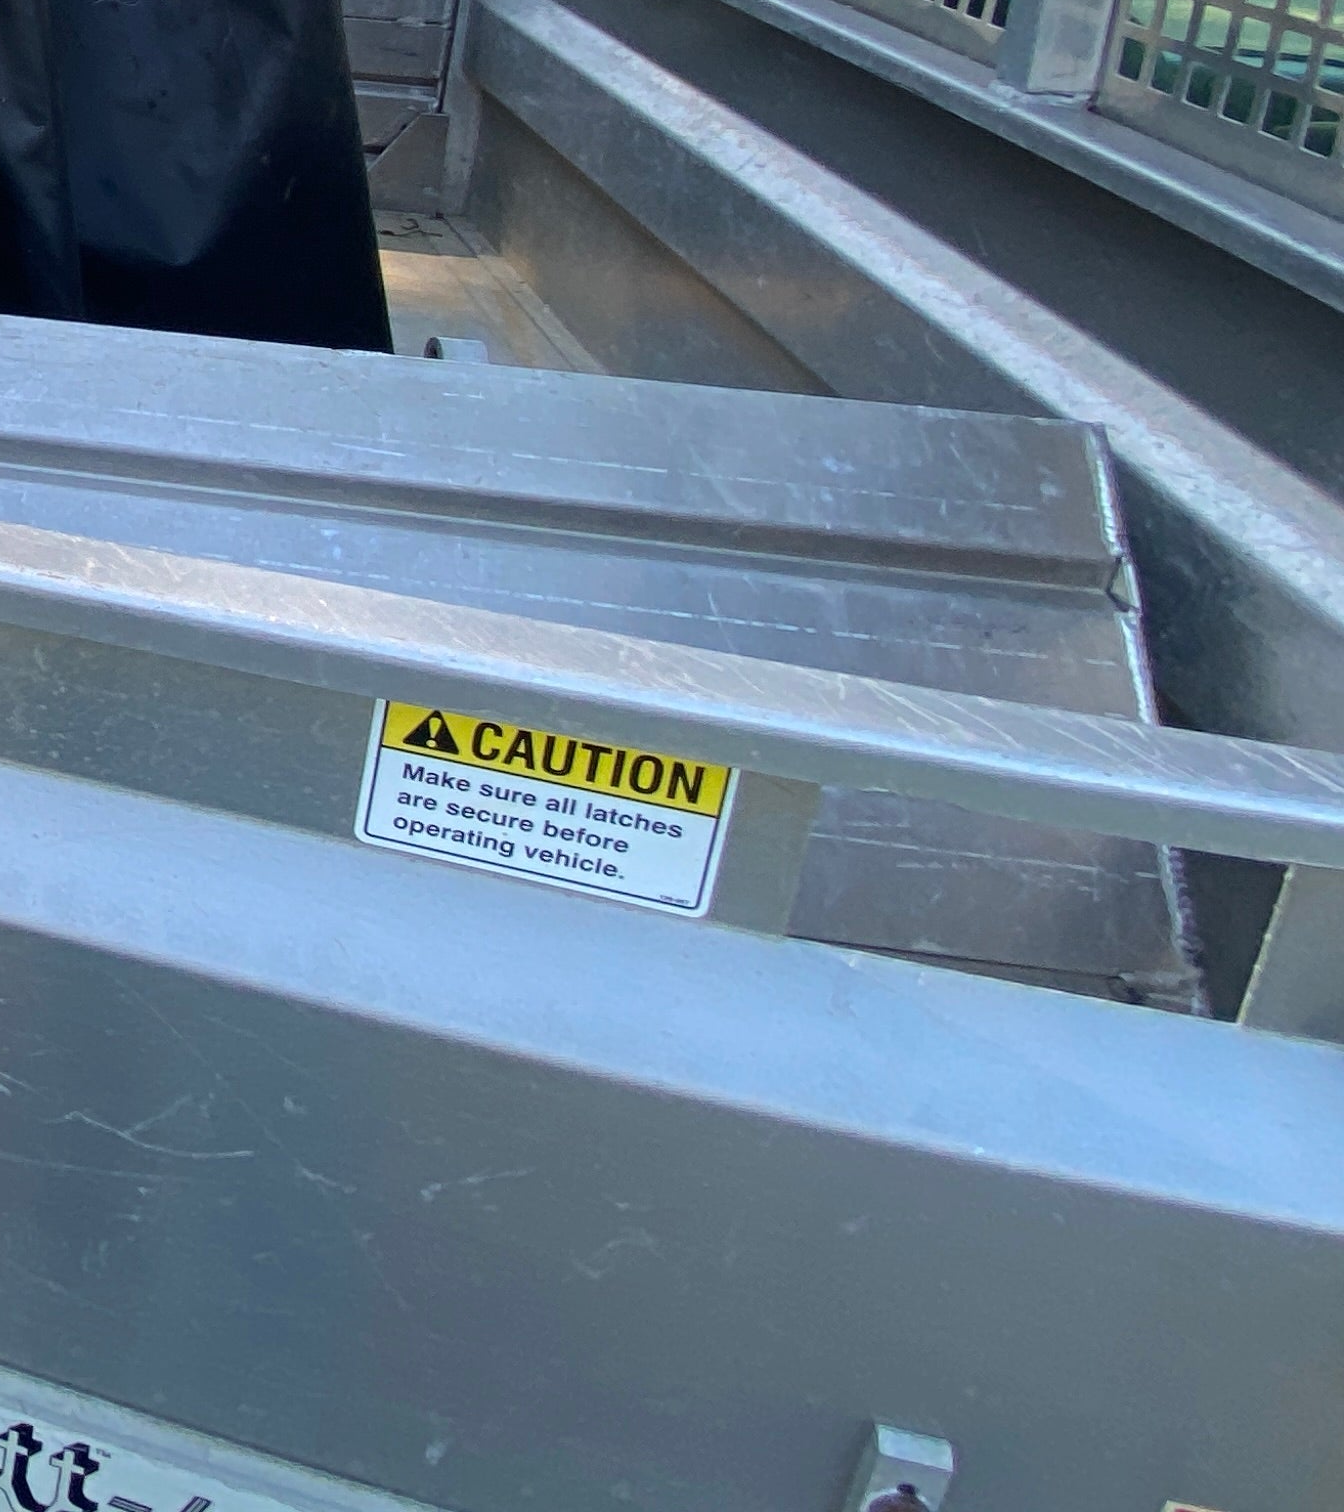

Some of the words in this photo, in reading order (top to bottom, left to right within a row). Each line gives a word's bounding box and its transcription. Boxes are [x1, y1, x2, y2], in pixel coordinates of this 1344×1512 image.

[471, 722, 704, 804] CAUTION
[397, 789, 438, 811] are
[445, 800, 534, 832] secure
[543, 820, 630, 854] before
[402, 762, 471, 792] Make
[479, 782, 537, 807] sure
[545, 797, 577, 816] all
[585, 801, 683, 838] latches
[392, 814, 515, 857] operating
[524, 845, 626, 880] vehicle.
